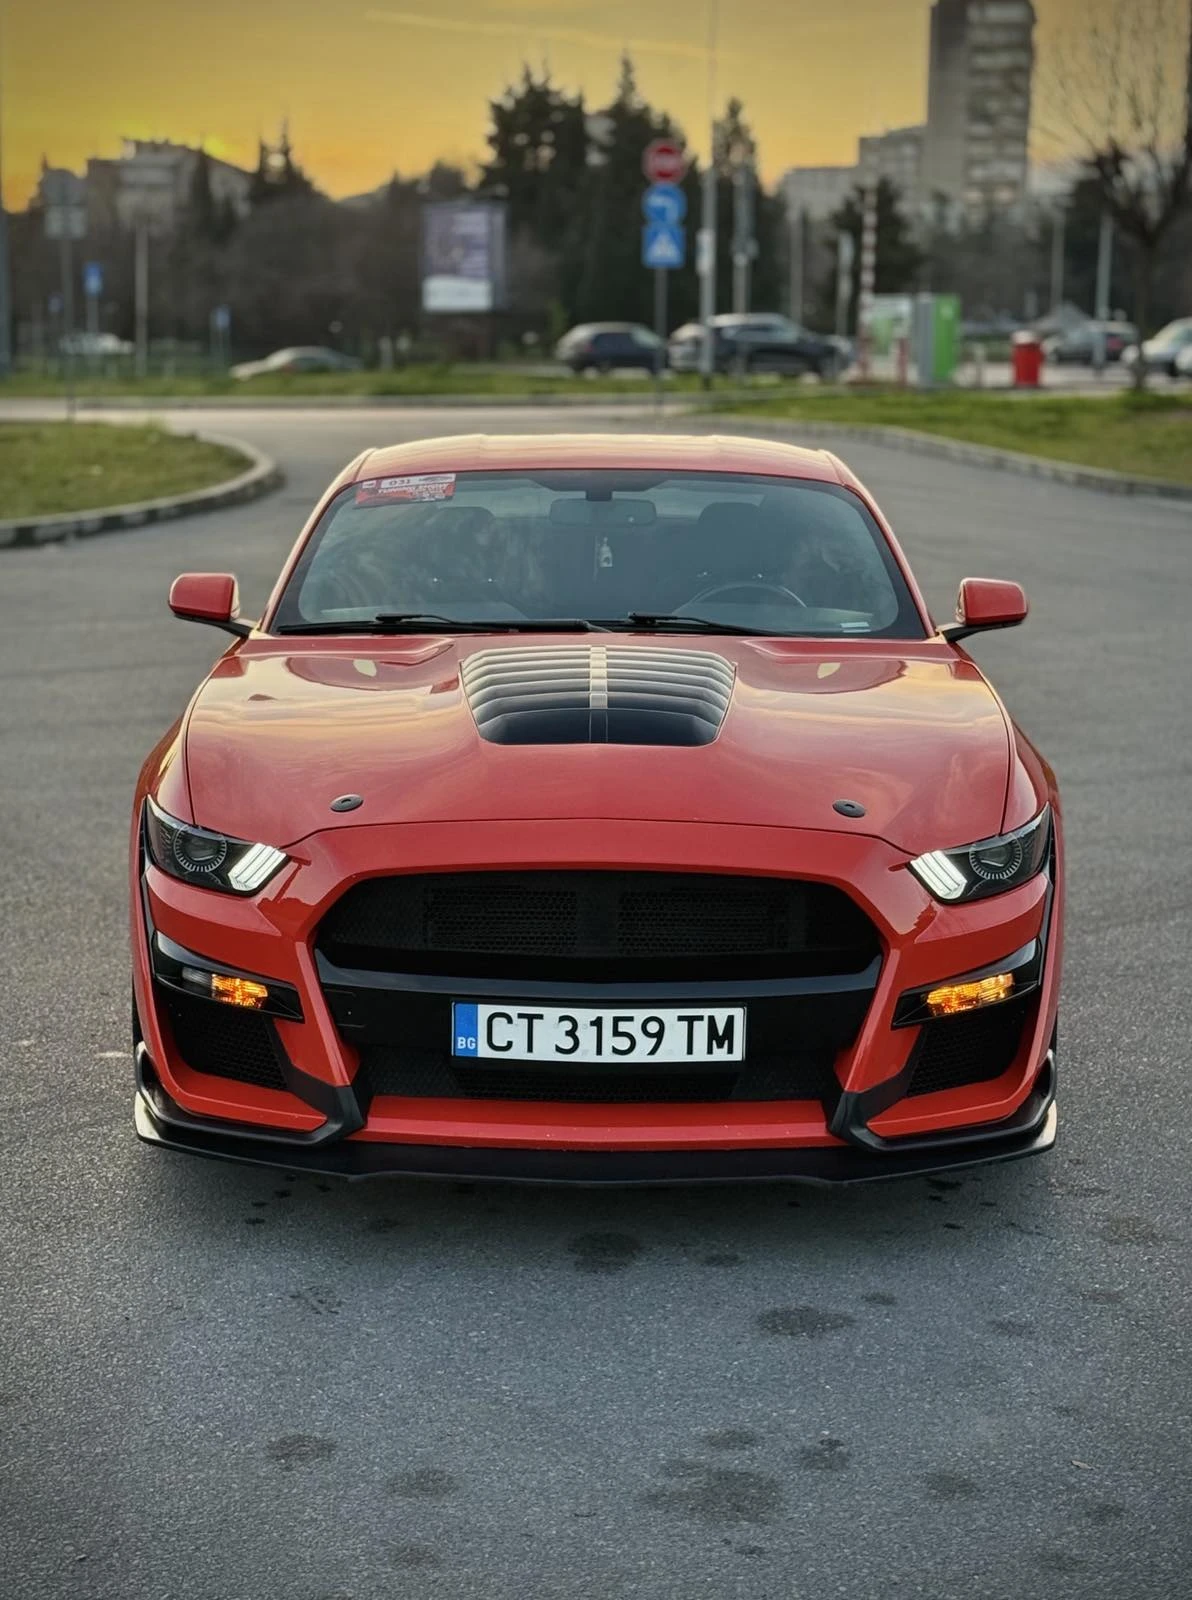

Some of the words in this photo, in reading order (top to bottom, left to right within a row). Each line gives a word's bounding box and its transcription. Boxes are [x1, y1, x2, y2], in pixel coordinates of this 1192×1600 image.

[457, 1037, 476, 1050] BG
[487, 1012, 543, 1052] CT
[555, 1015, 665, 1056] 3159
[677, 1015, 734, 1055] TM
